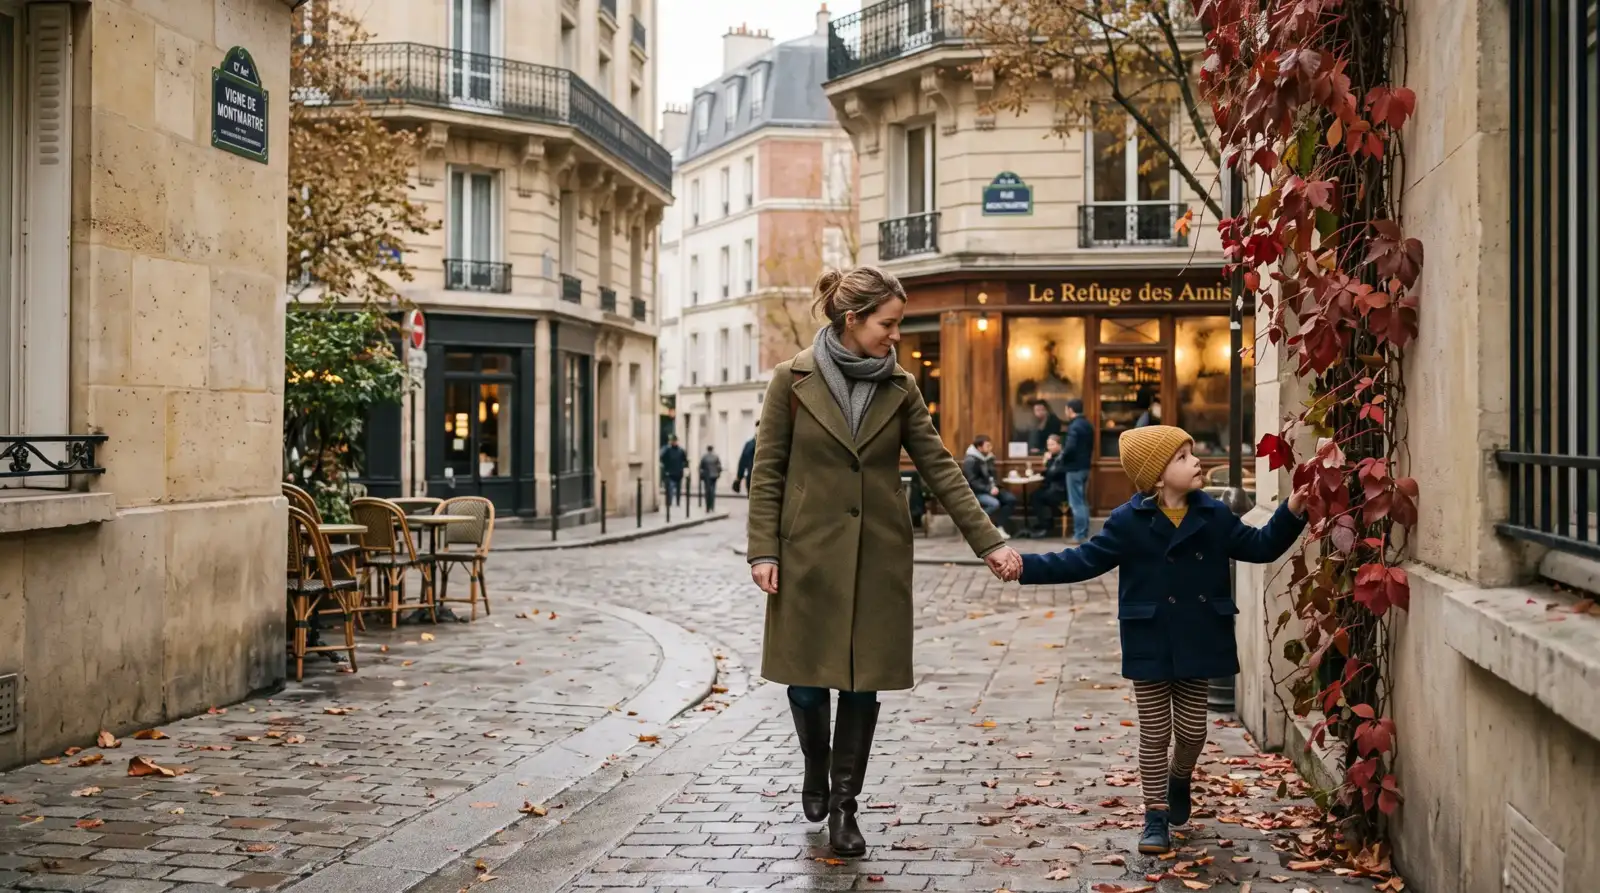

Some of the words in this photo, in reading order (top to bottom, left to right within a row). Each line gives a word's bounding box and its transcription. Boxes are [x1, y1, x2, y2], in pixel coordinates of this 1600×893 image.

[225, 87, 246, 108] VIGNE
[247, 96, 256, 111] DE
[217, 101, 264, 132] MONTMARTRE
[1028, 283, 1054, 302] Le
[1061, 282, 1132, 306] Refuge
[1138, 282, 1173, 301] des
[1178, 282, 1232, 301] Amis
